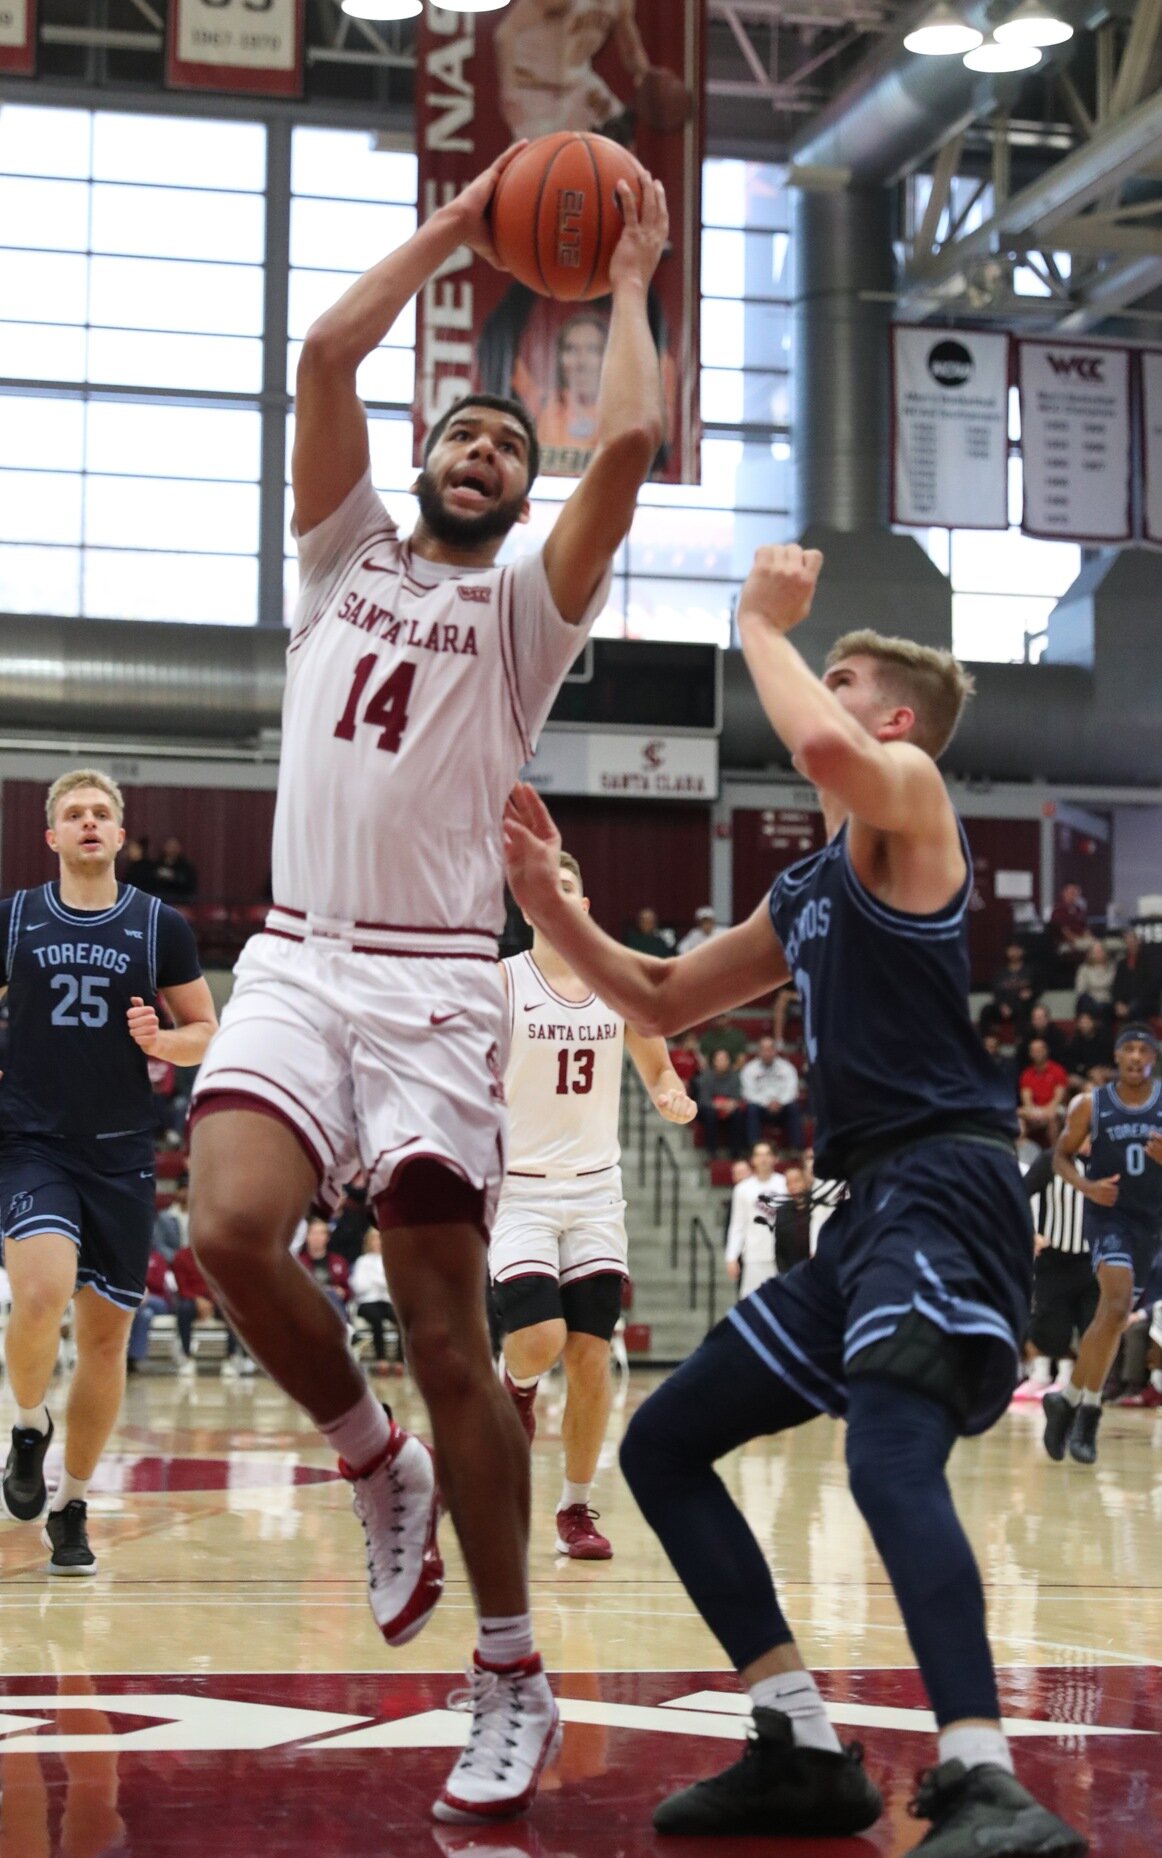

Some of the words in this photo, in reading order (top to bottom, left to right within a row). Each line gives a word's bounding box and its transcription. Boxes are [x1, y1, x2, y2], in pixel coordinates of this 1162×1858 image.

[1046, 354, 1105, 383] WCC
[337, 592, 401, 646] SANTA
[402, 618, 478, 656] LARA
[333, 652, 417, 755] 14
[32, 943, 131, 974] TOREROS
[50, 973, 111, 1028] 25
[528, 1023, 574, 1041] SANTA
[556, 1048, 595, 1095] 13
[1126, 1142, 1146, 1176] 0
